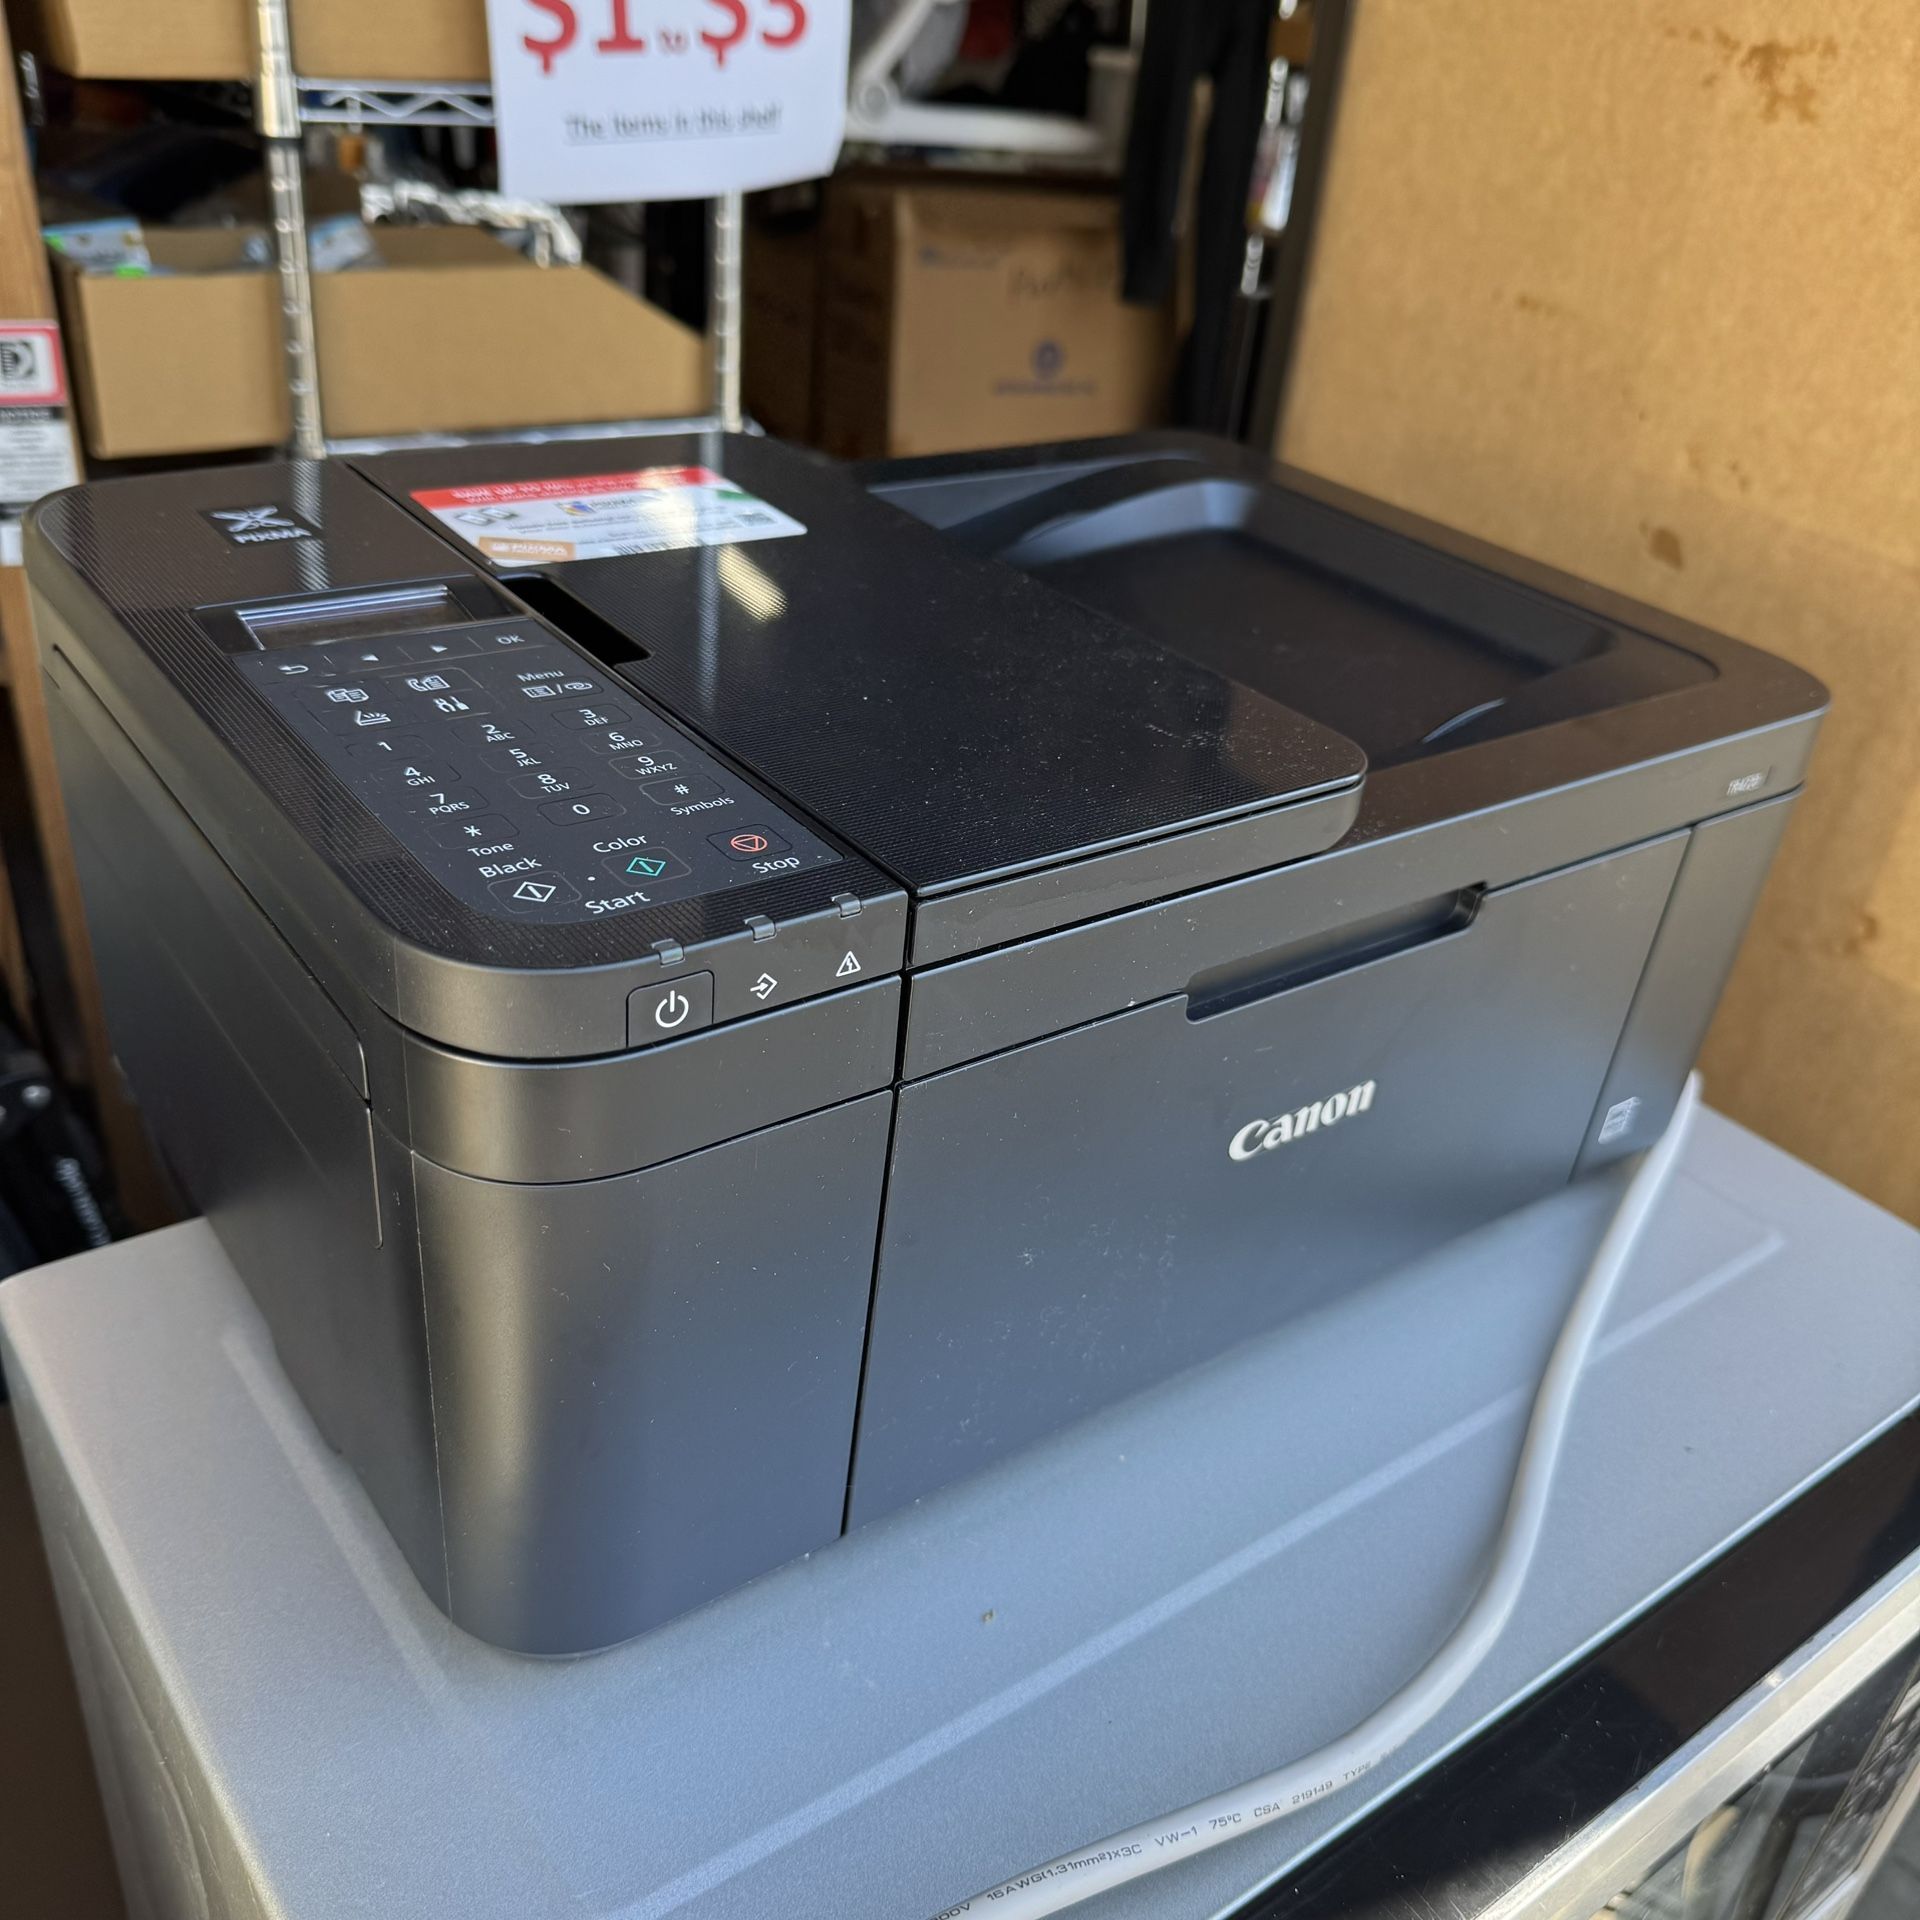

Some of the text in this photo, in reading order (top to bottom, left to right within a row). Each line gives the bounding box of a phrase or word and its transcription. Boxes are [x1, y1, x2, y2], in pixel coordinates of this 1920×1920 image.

[523, 0, 645, 75] $1
[497, 634, 525, 645] OK
[516, 670, 564, 682] Menu
[579, 708, 596, 719] 3
[584, 716, 608, 726] DEF
[481, 724, 500, 734] 2
[486, 732, 515, 743] ABC
[608, 731, 625, 742] 6
[377, 741, 392, 751] 1
[609, 739, 643, 751] MNO
[509, 748, 527, 759] 5
[516, 757, 542, 767] JKL
[637, 756, 655, 766] 9
[404, 766, 421, 776] 4
[635, 762, 678, 776] WXYZ
[407, 775, 436, 786] GHI
[537, 773, 556, 784] 8
[540, 782, 571, 794] TUV
[674, 784, 690, 795] #
[429, 793, 445, 804] 7
[428, 801, 470, 815] PQRS
[572, 804, 591, 815] 0
[670, 796, 735, 816] Symbols
[592, 834, 648, 854] Color
[467, 843, 515, 858] Tone
[479, 857, 542, 879] Black
[752, 856, 801, 874] Stop
[585, 891, 651, 915] Start
[1228, 1079, 1377, 1161] Canon
[1154, 1826, 1199, 1847] VW-1
[1253, 1801, 1281, 1819] CSA
